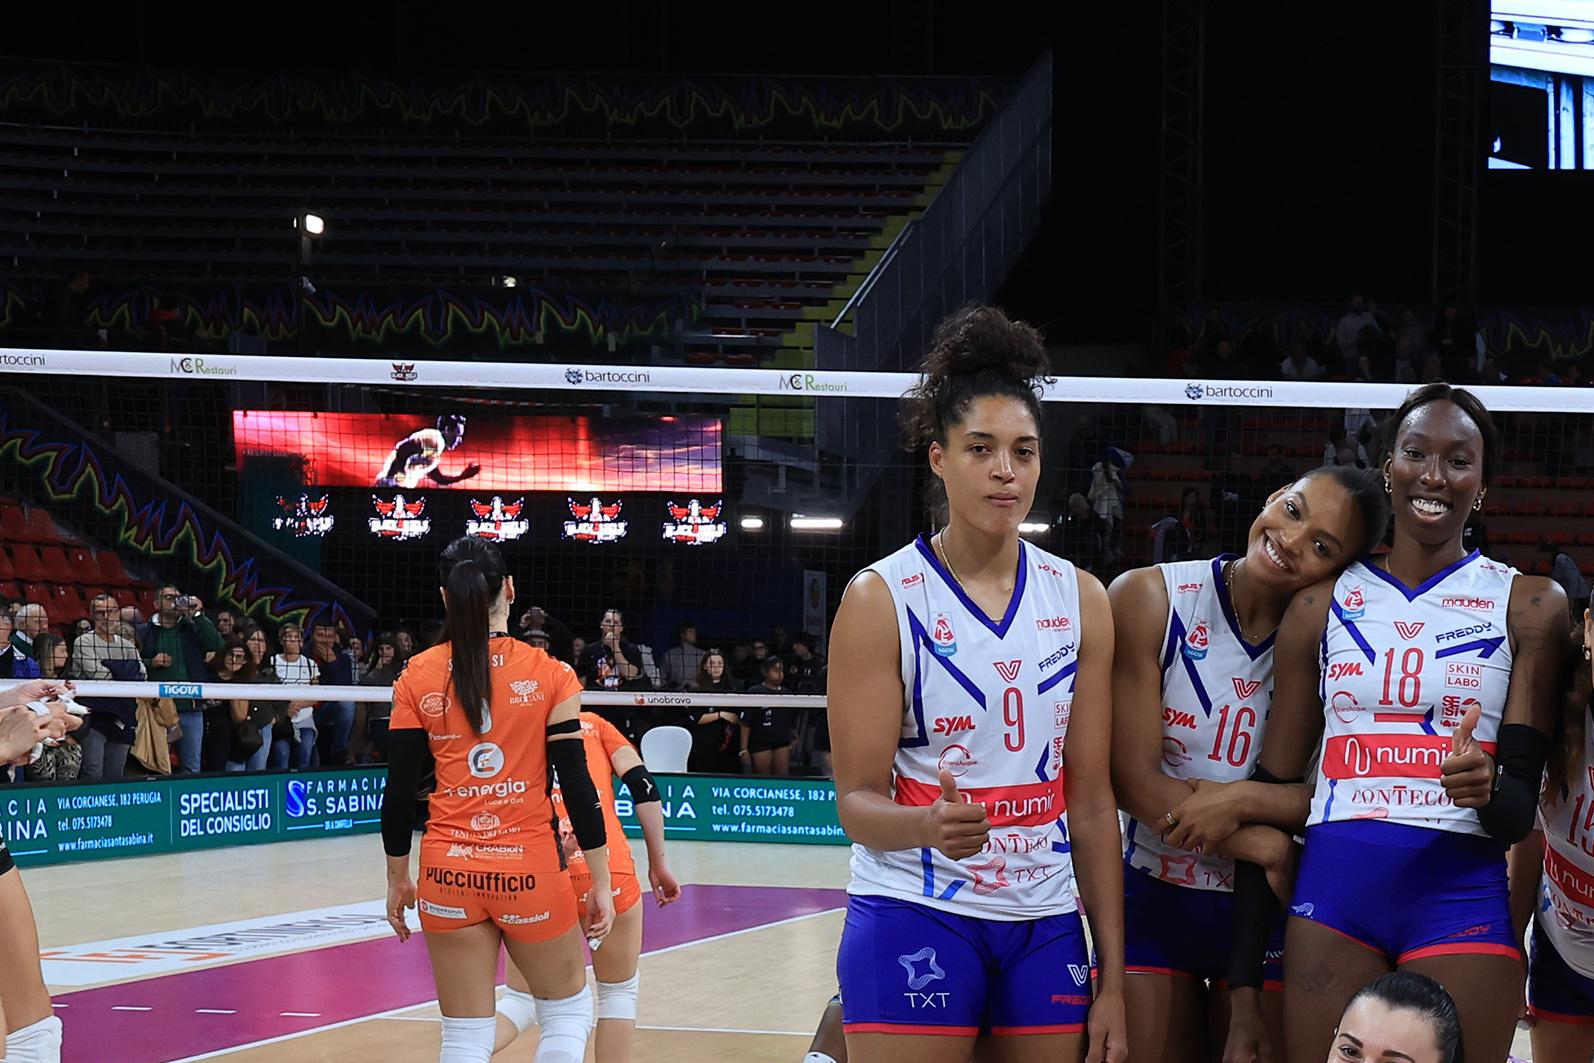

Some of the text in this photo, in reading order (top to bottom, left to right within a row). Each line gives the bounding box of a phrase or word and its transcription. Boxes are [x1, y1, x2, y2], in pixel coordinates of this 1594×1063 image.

[585, 369, 650, 384] bartoccini
[1206, 385, 1273, 399] bartoccini
[1442, 597, 1495, 610] mauden
[1435, 622, 1492, 643] FREDDY
[1038, 642, 1075, 672] FREDDY
[1328, 662, 1364, 681] SYM
[1378, 647, 1424, 708] 18
[1448, 664, 1480, 675] SKIN
[1447, 677, 1479, 687] LABO
[647, 695, 691, 704] unobravo
[933, 715, 976, 736] SYM
[1003, 687, 1025, 752] 9
[1162, 707, 1198, 729] SYM
[1208, 704, 1256, 767] 16
[306, 777, 387, 794] FARMACIA
[711, 787, 825, 801] VIA CORCIANESE, 182
[57, 791, 162, 810] VIA CORCIANESE, 182 PERUGIA
[180, 788, 270, 815] SPECIALISTI
[306, 799, 322, 816] S.
[711, 804, 795, 818] tel. 075.5173478
[57, 815, 113, 831] tel. 075.5173478
[180, 811, 272, 837] DEL CONSIGLIO
[57, 832, 154, 851] www.farmaciasantasabina.it
[904, 992, 950, 1008] TXT
